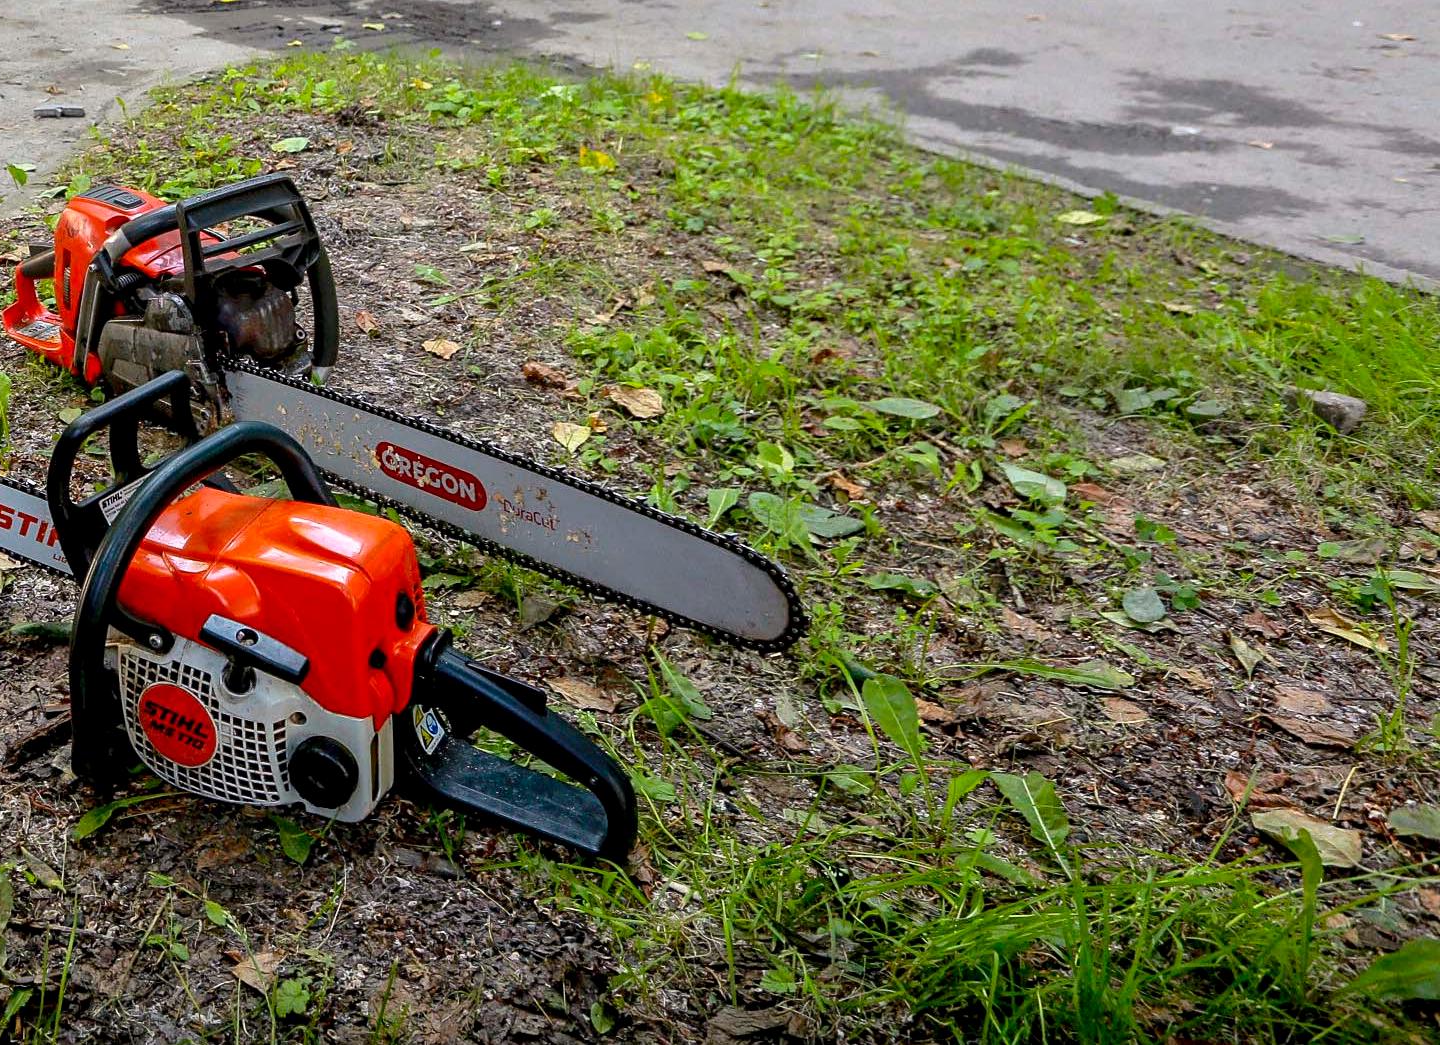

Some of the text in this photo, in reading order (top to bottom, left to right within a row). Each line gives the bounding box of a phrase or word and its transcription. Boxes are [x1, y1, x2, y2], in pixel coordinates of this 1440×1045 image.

[381, 446, 477, 503] OREGON
[102, 491, 122, 509] STIHL
[503, 499, 559, 531] DuraCut
[144, 701, 208, 738] STIHL
[178, 732, 205, 750] 170
